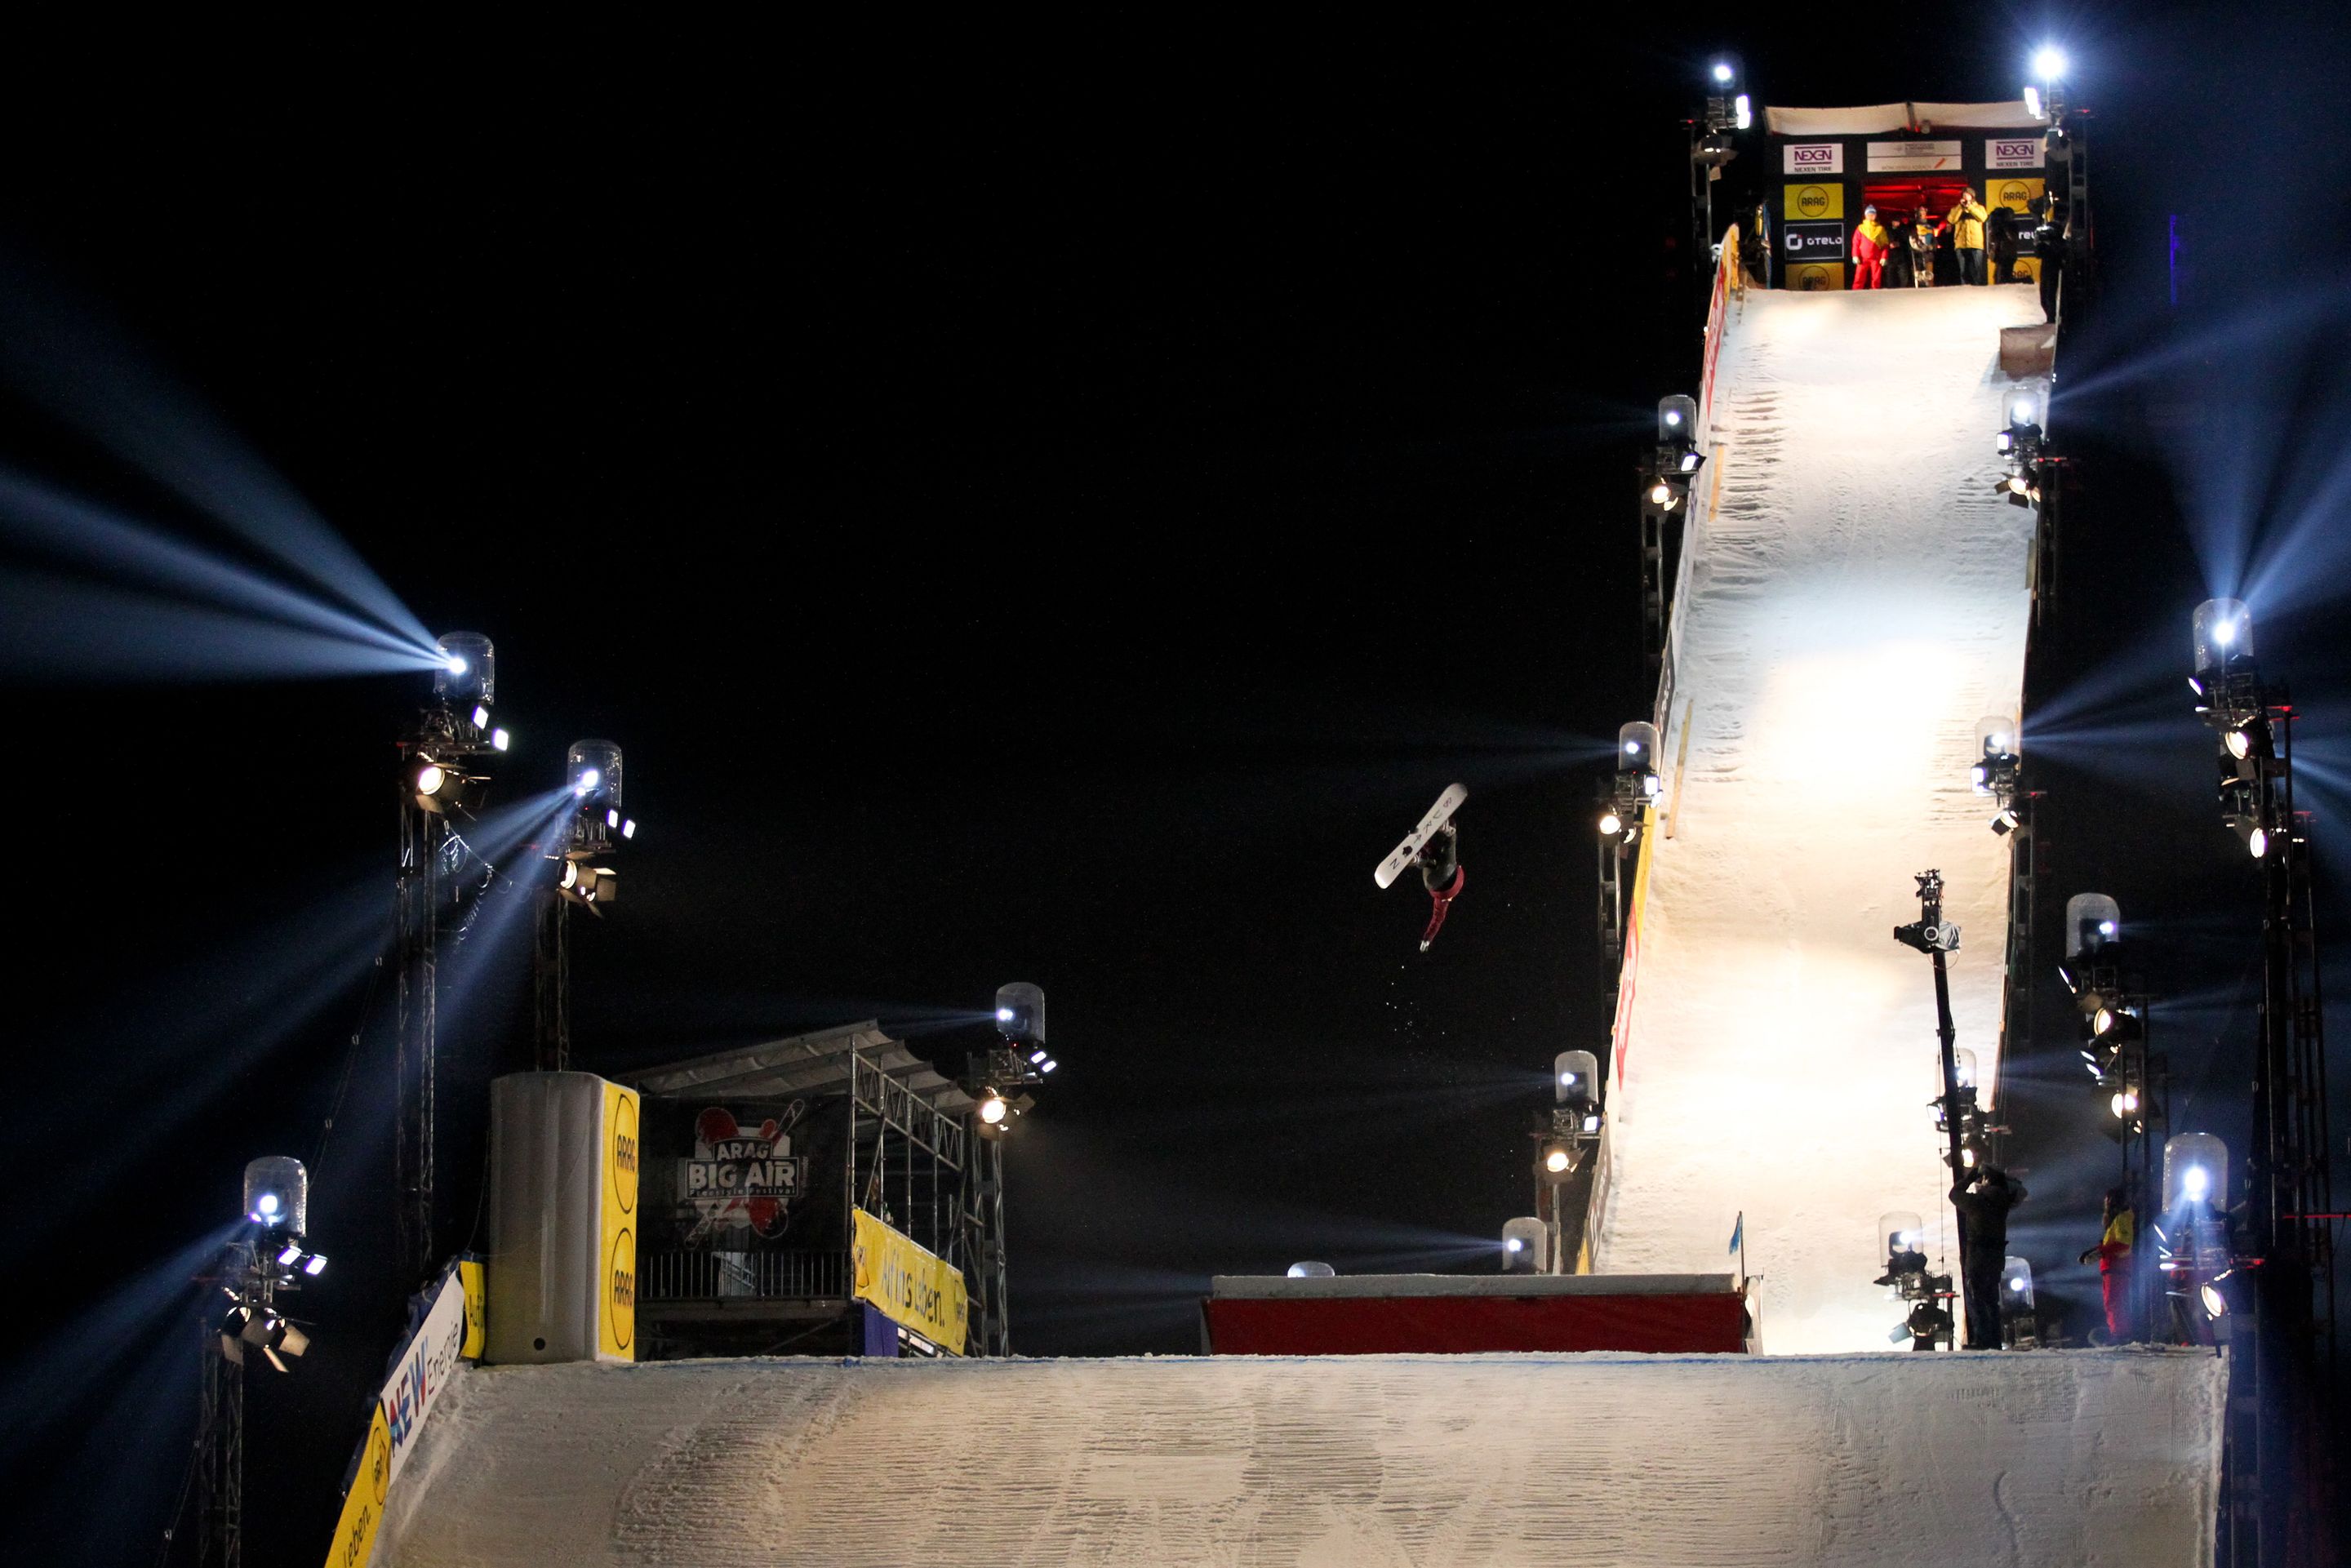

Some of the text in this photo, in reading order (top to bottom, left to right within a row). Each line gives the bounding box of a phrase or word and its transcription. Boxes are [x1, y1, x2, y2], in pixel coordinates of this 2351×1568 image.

[1794, 149, 1832, 162] NEXEN
[1997, 144, 2034, 156] NEXEN
[1802, 197, 1825, 207] ARAG
[2003, 191, 2027, 202] ARAG
[616, 1133, 636, 1174] ARAG
[717, 1142, 770, 1161] ARAG
[688, 1163, 738, 1189] BIG
[744, 1160, 796, 1187] AIR
[614, 1268, 633, 1309] ARAG
[389, 1320, 459, 1459] NEW Energie
